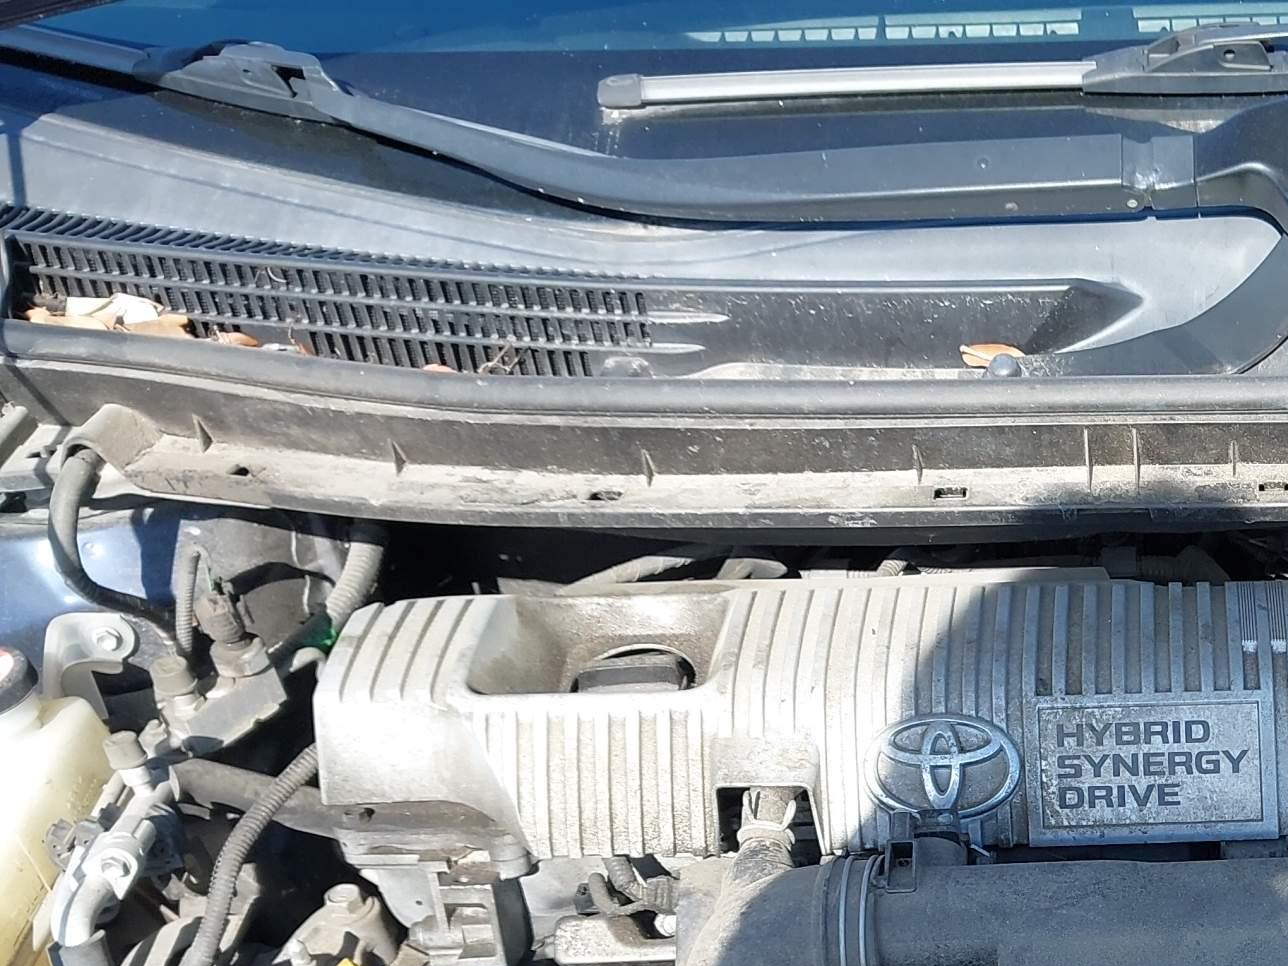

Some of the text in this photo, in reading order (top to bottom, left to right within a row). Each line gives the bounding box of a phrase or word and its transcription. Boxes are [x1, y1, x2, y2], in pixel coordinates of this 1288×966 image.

[1056, 719, 1211, 747] HYBRID
[1056, 749, 1249, 779] SYNERGY
[1057, 783, 1181, 810] DRIVE
